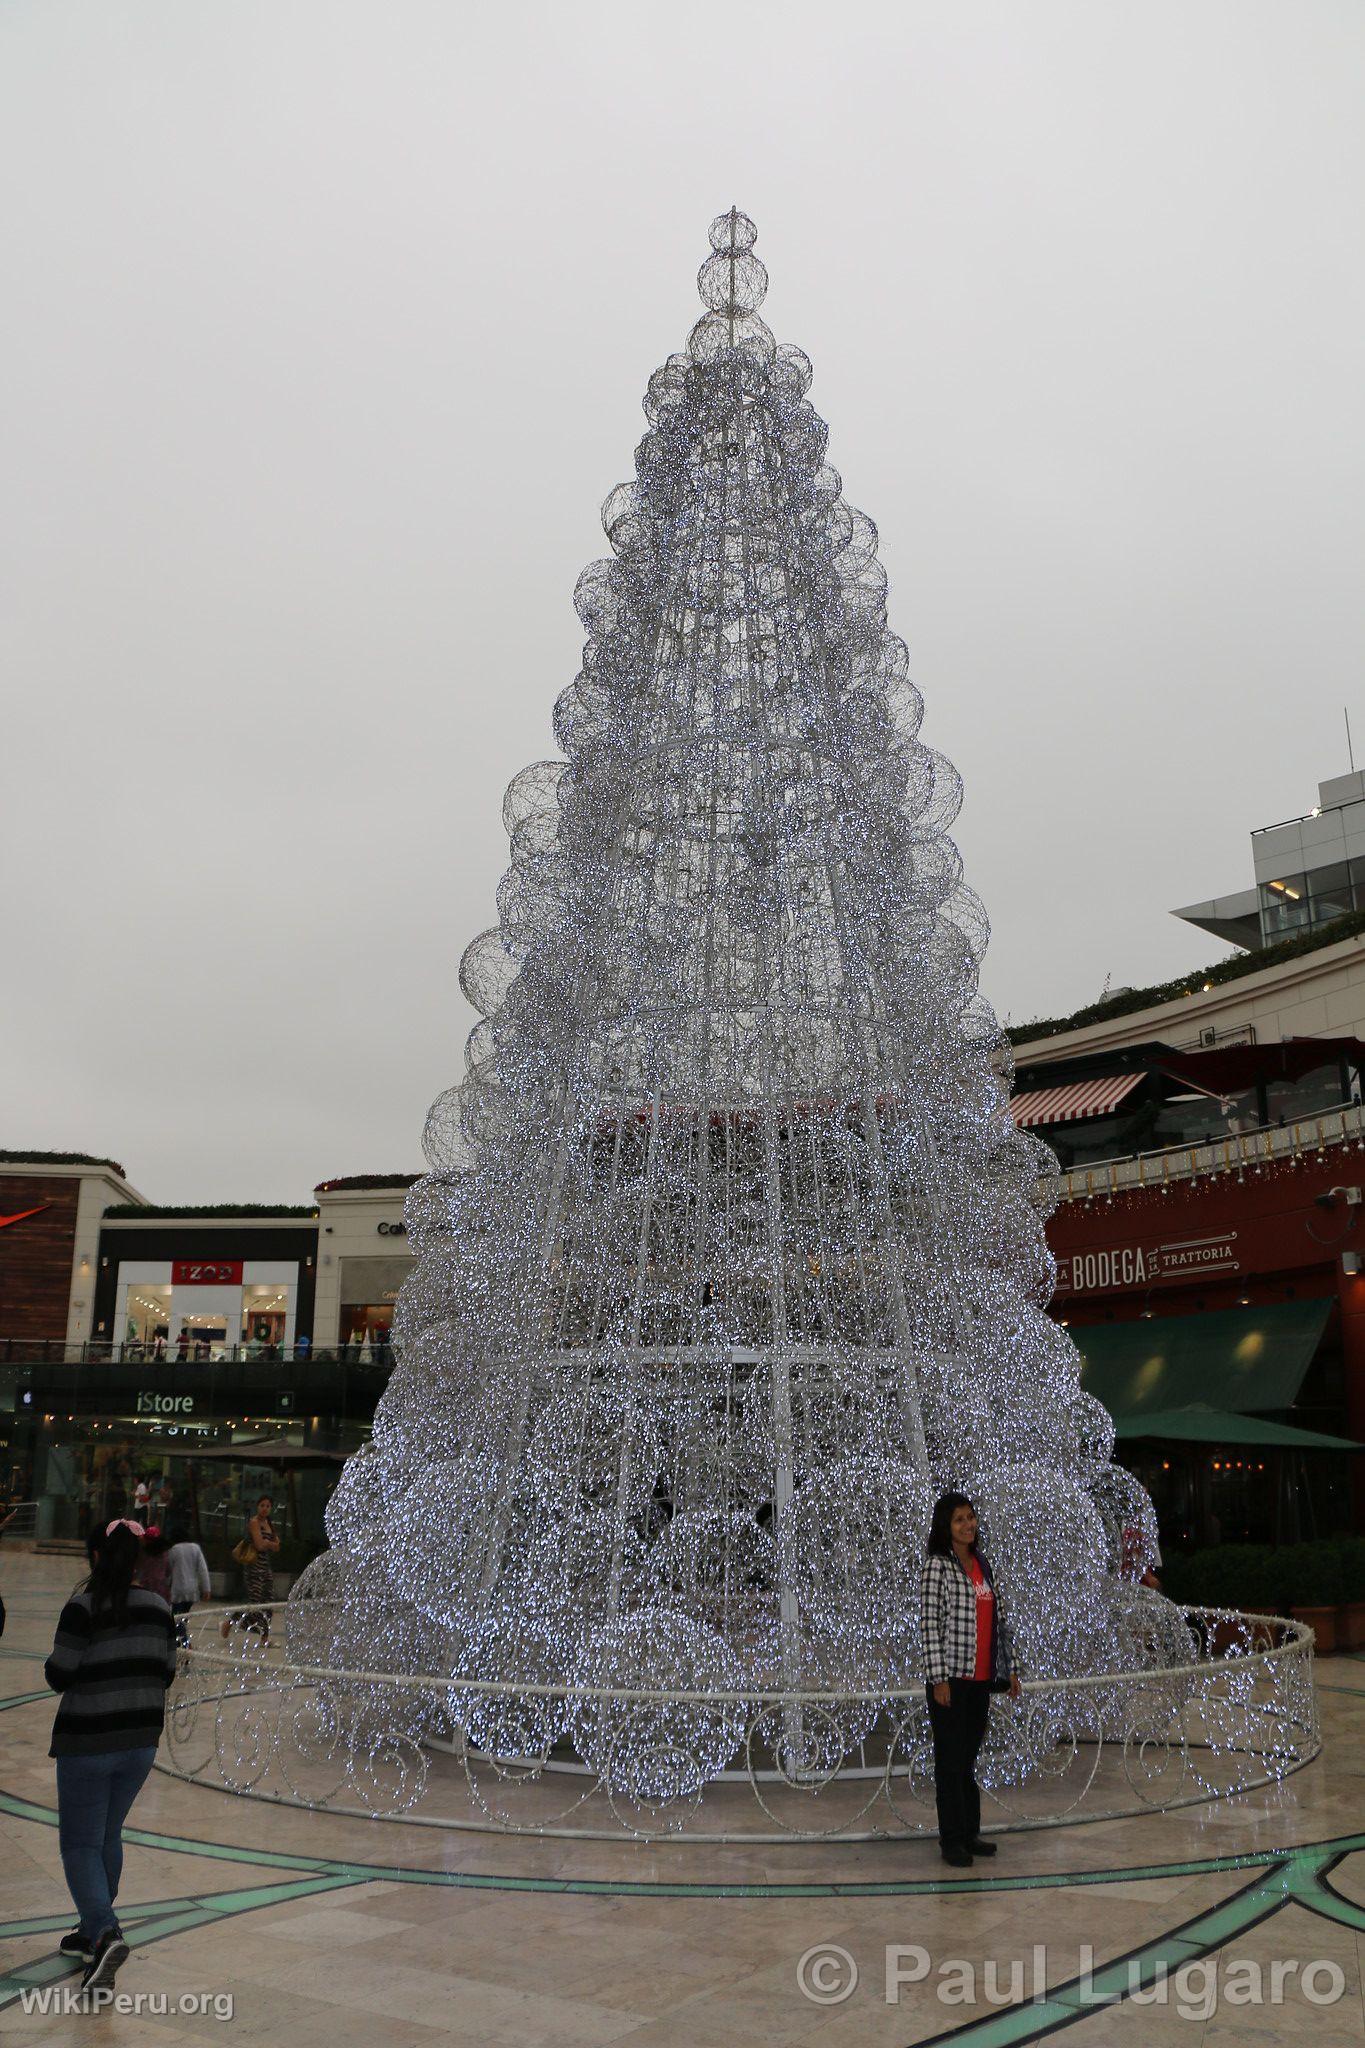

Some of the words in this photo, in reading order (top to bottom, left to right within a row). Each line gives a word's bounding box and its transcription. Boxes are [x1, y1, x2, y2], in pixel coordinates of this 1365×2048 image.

[180, 1264, 233, 1280] IZOD
[1073, 1247, 1146, 1291] BODEGA
[1162, 1246, 1233, 1266] TRATTORIA
[136, 1391, 194, 1412] iStore
